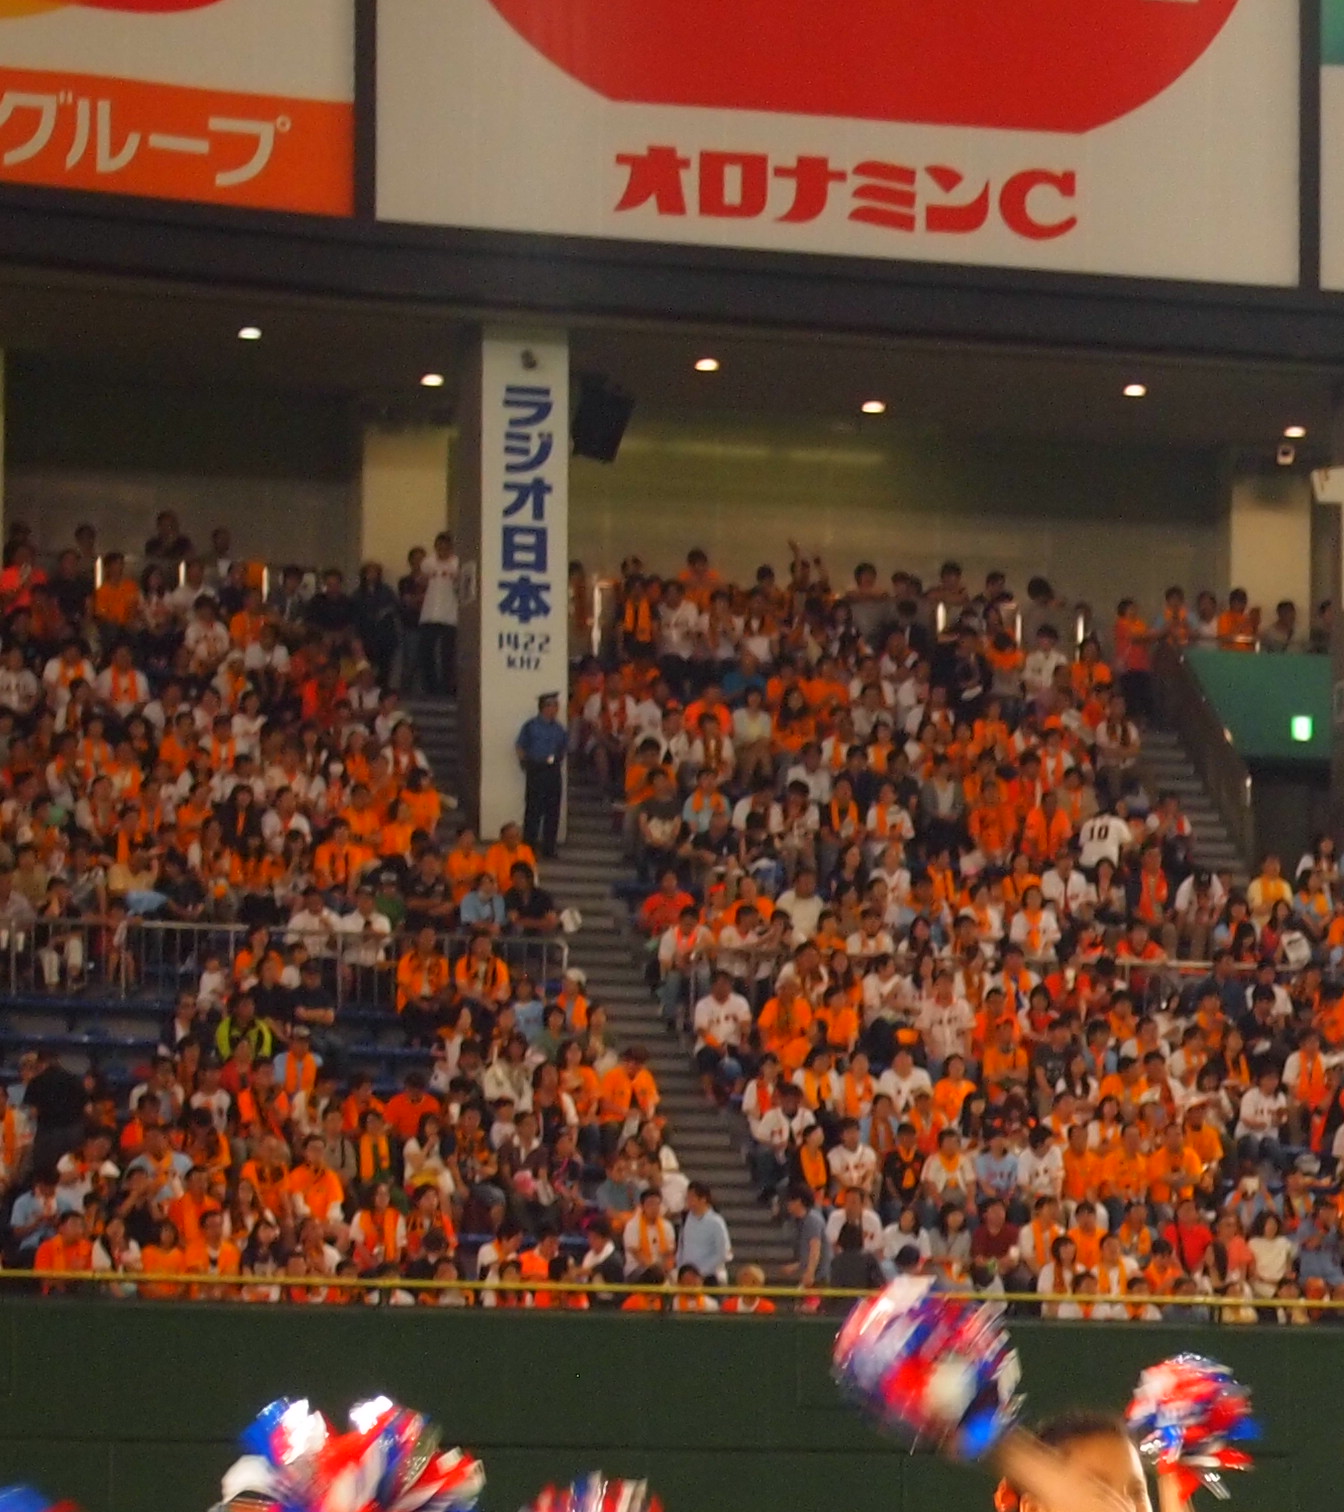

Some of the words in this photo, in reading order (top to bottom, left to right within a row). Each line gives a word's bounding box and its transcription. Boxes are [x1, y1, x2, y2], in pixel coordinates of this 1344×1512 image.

[0, 90, 292, 188] グループ
[613, 145, 1078, 241] オロナミンC
[499, 385, 554, 624] ラジオ日本
